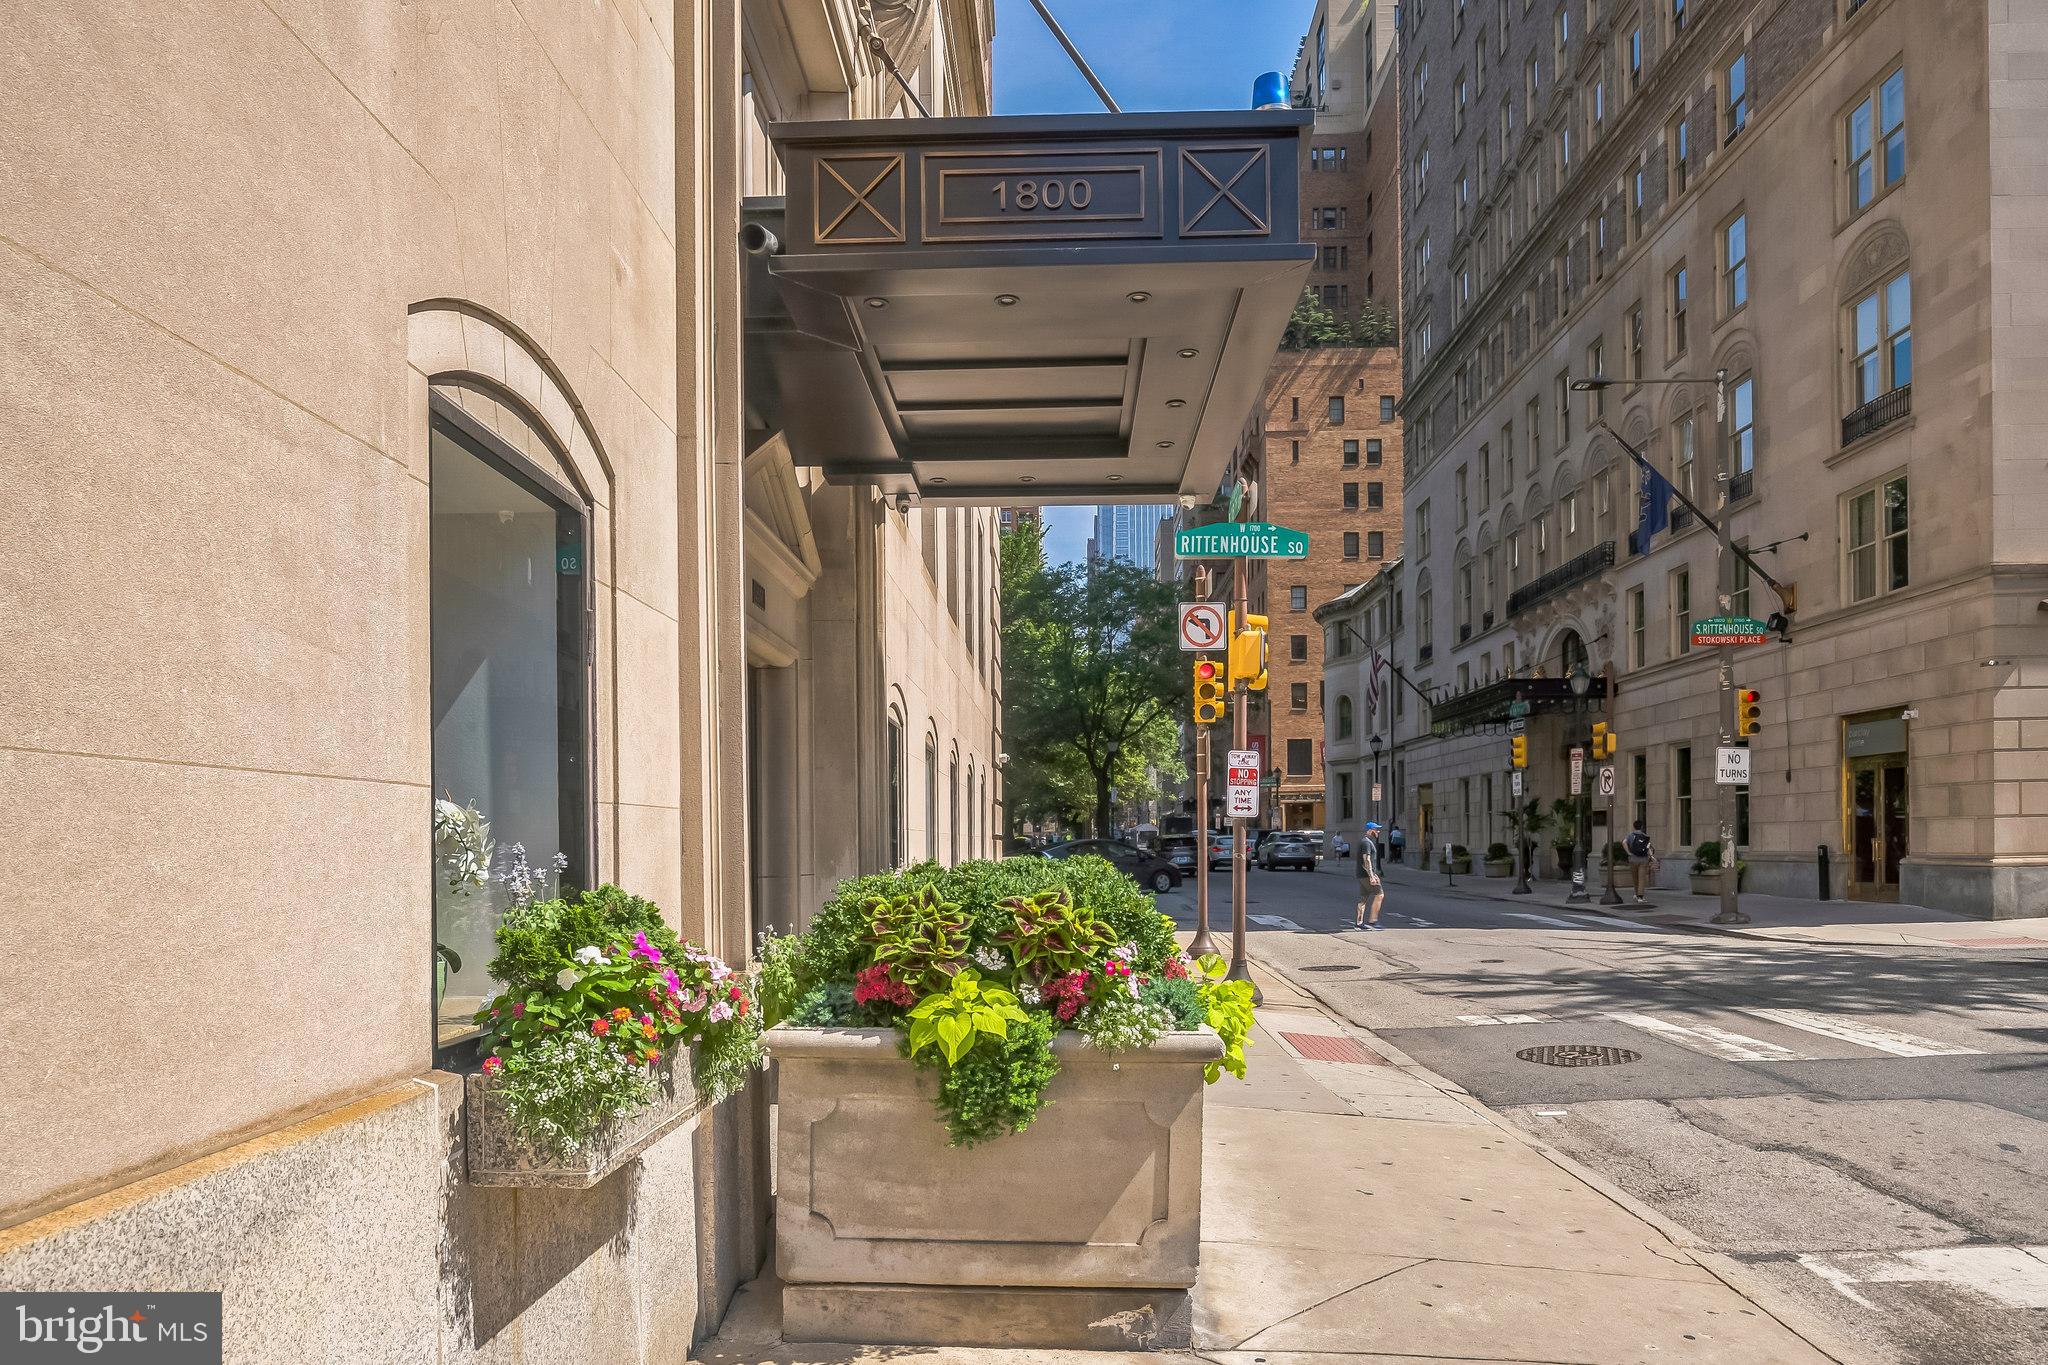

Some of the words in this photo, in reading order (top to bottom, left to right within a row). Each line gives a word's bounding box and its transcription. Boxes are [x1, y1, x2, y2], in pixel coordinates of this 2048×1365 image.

[992, 179, 1092, 210] 1800
[1239, 524, 1246, 533] W
[1181, 535, 1278, 554] RITTENHOUSE
[1287, 541, 1303, 554] SQ
[1697, 636, 1738, 644] STOKOWSKI
[1739, 635, 1761, 644] PLACE
[1727, 753, 1741, 765] NO
[1237, 769, 1249, 779] NO
[1719, 768, 1748, 779] TURNS
[1229, 778, 1257, 786] STOPPING
